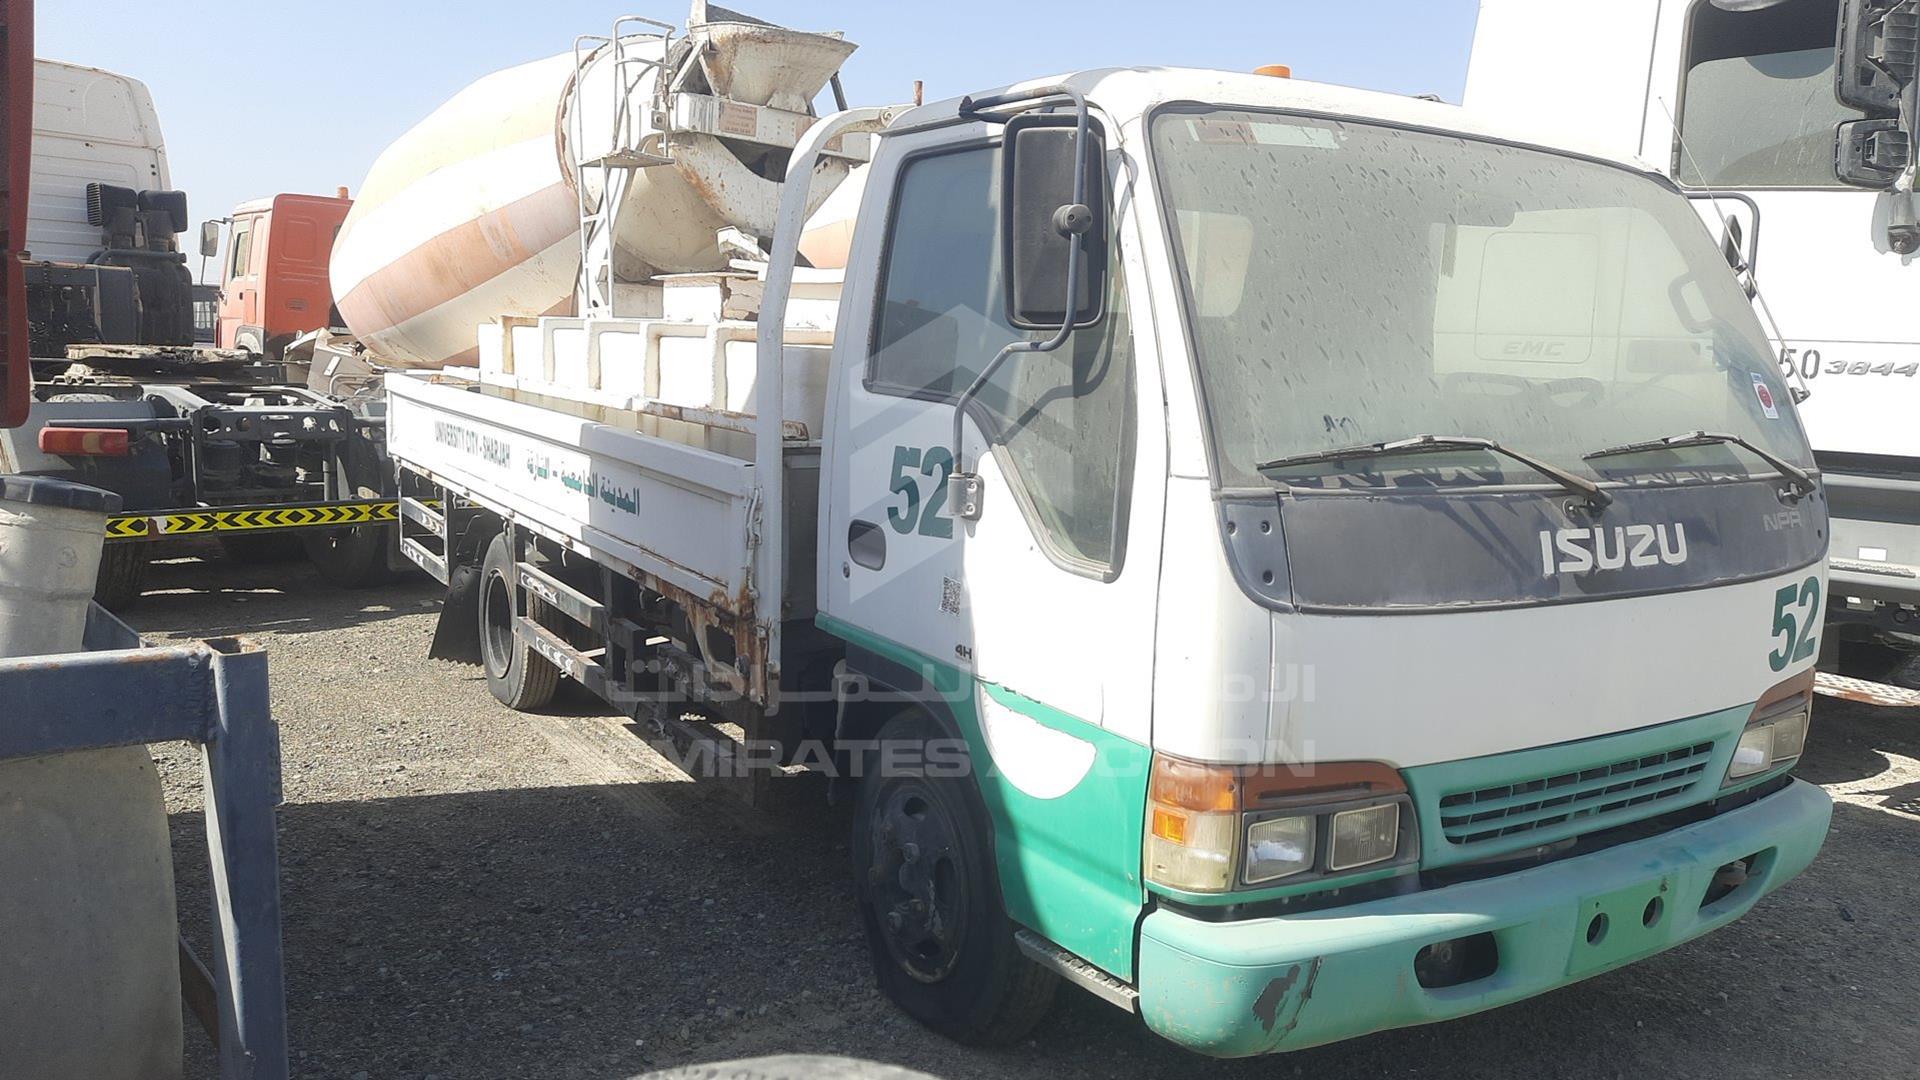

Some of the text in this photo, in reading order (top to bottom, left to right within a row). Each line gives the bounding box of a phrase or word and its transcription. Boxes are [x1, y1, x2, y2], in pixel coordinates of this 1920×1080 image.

[1502, 340, 1566, 357] EMC
[1824, 359, 1920, 377] 3844
[465, 429, 479, 457] CITY
[600, 476, 640, 517] المدينة
[887, 445, 954, 540] 52
[1538, 522, 1688, 577] ISUZU
[1768, 575, 1820, 673] 52
